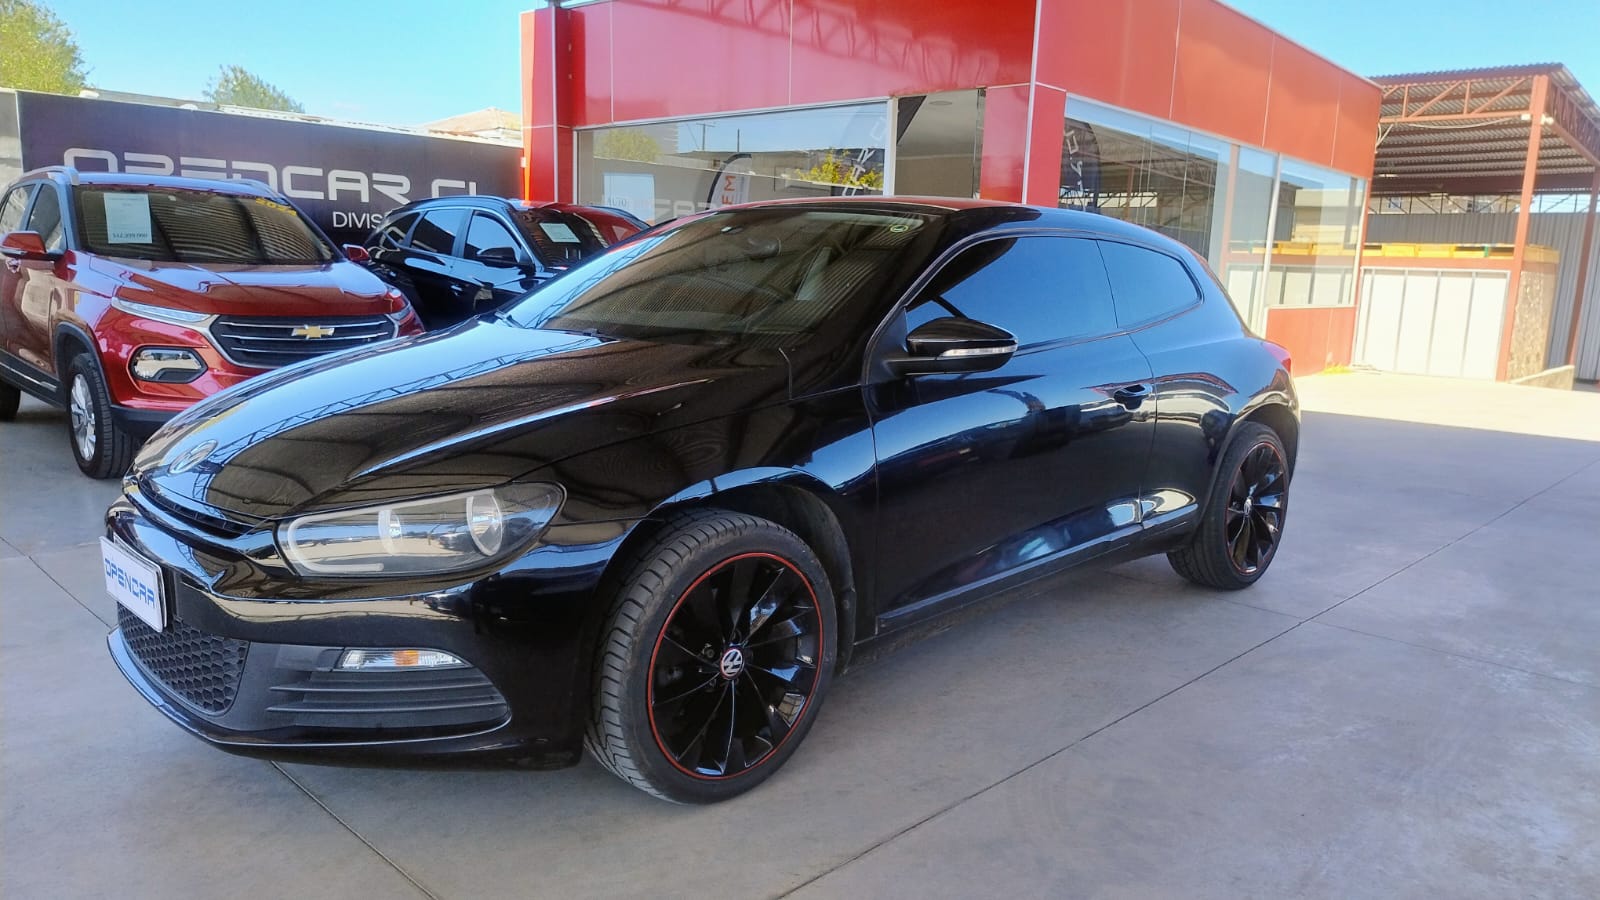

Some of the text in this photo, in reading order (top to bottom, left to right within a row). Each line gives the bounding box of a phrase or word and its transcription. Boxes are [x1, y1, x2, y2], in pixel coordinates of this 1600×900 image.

[64, 147, 411, 205] OPENCAR
[332, 211, 384, 229] DIVIS
[104, 557, 156, 608] OPENCAR
